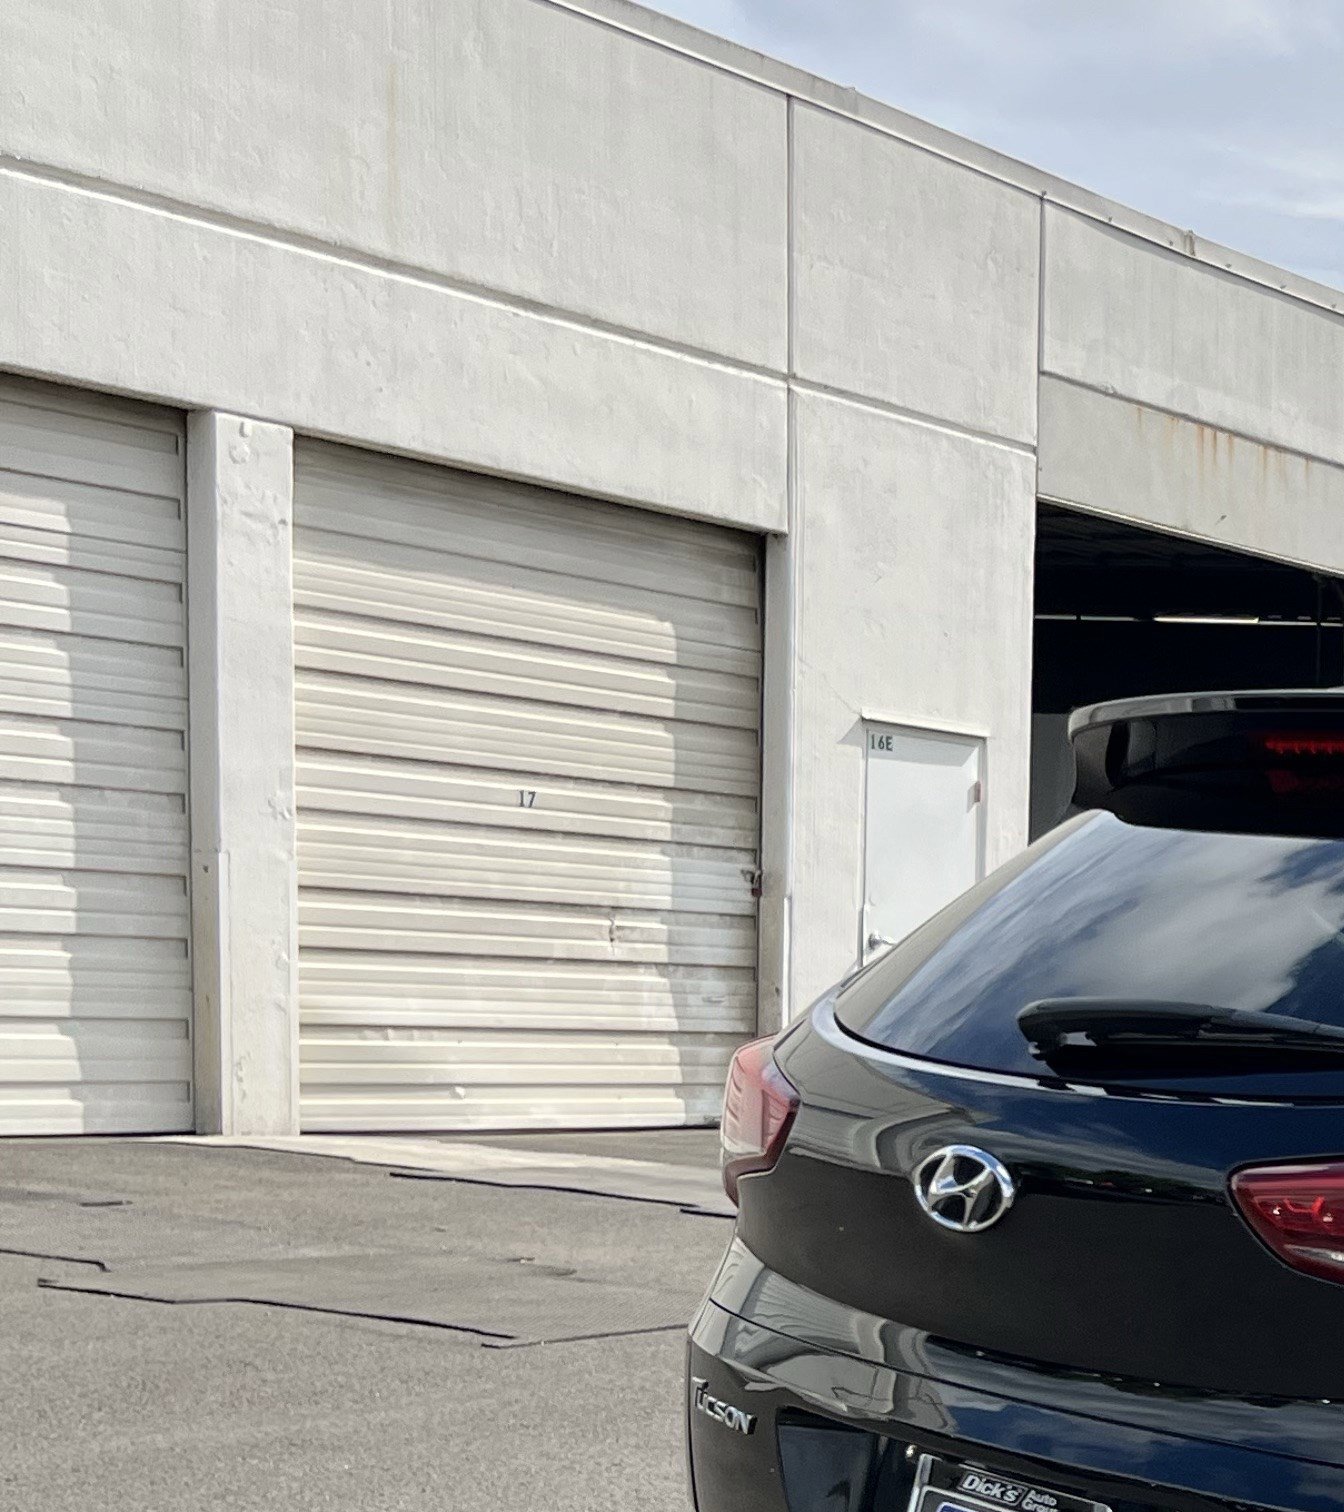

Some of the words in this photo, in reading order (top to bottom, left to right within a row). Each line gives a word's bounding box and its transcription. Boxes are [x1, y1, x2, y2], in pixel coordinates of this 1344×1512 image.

[871, 734, 893, 751] 16E
[519, 789, 536, 808] 17
[962, 1474, 1019, 1502] Dick's
[1026, 1489, 1058, 1507] Auto
